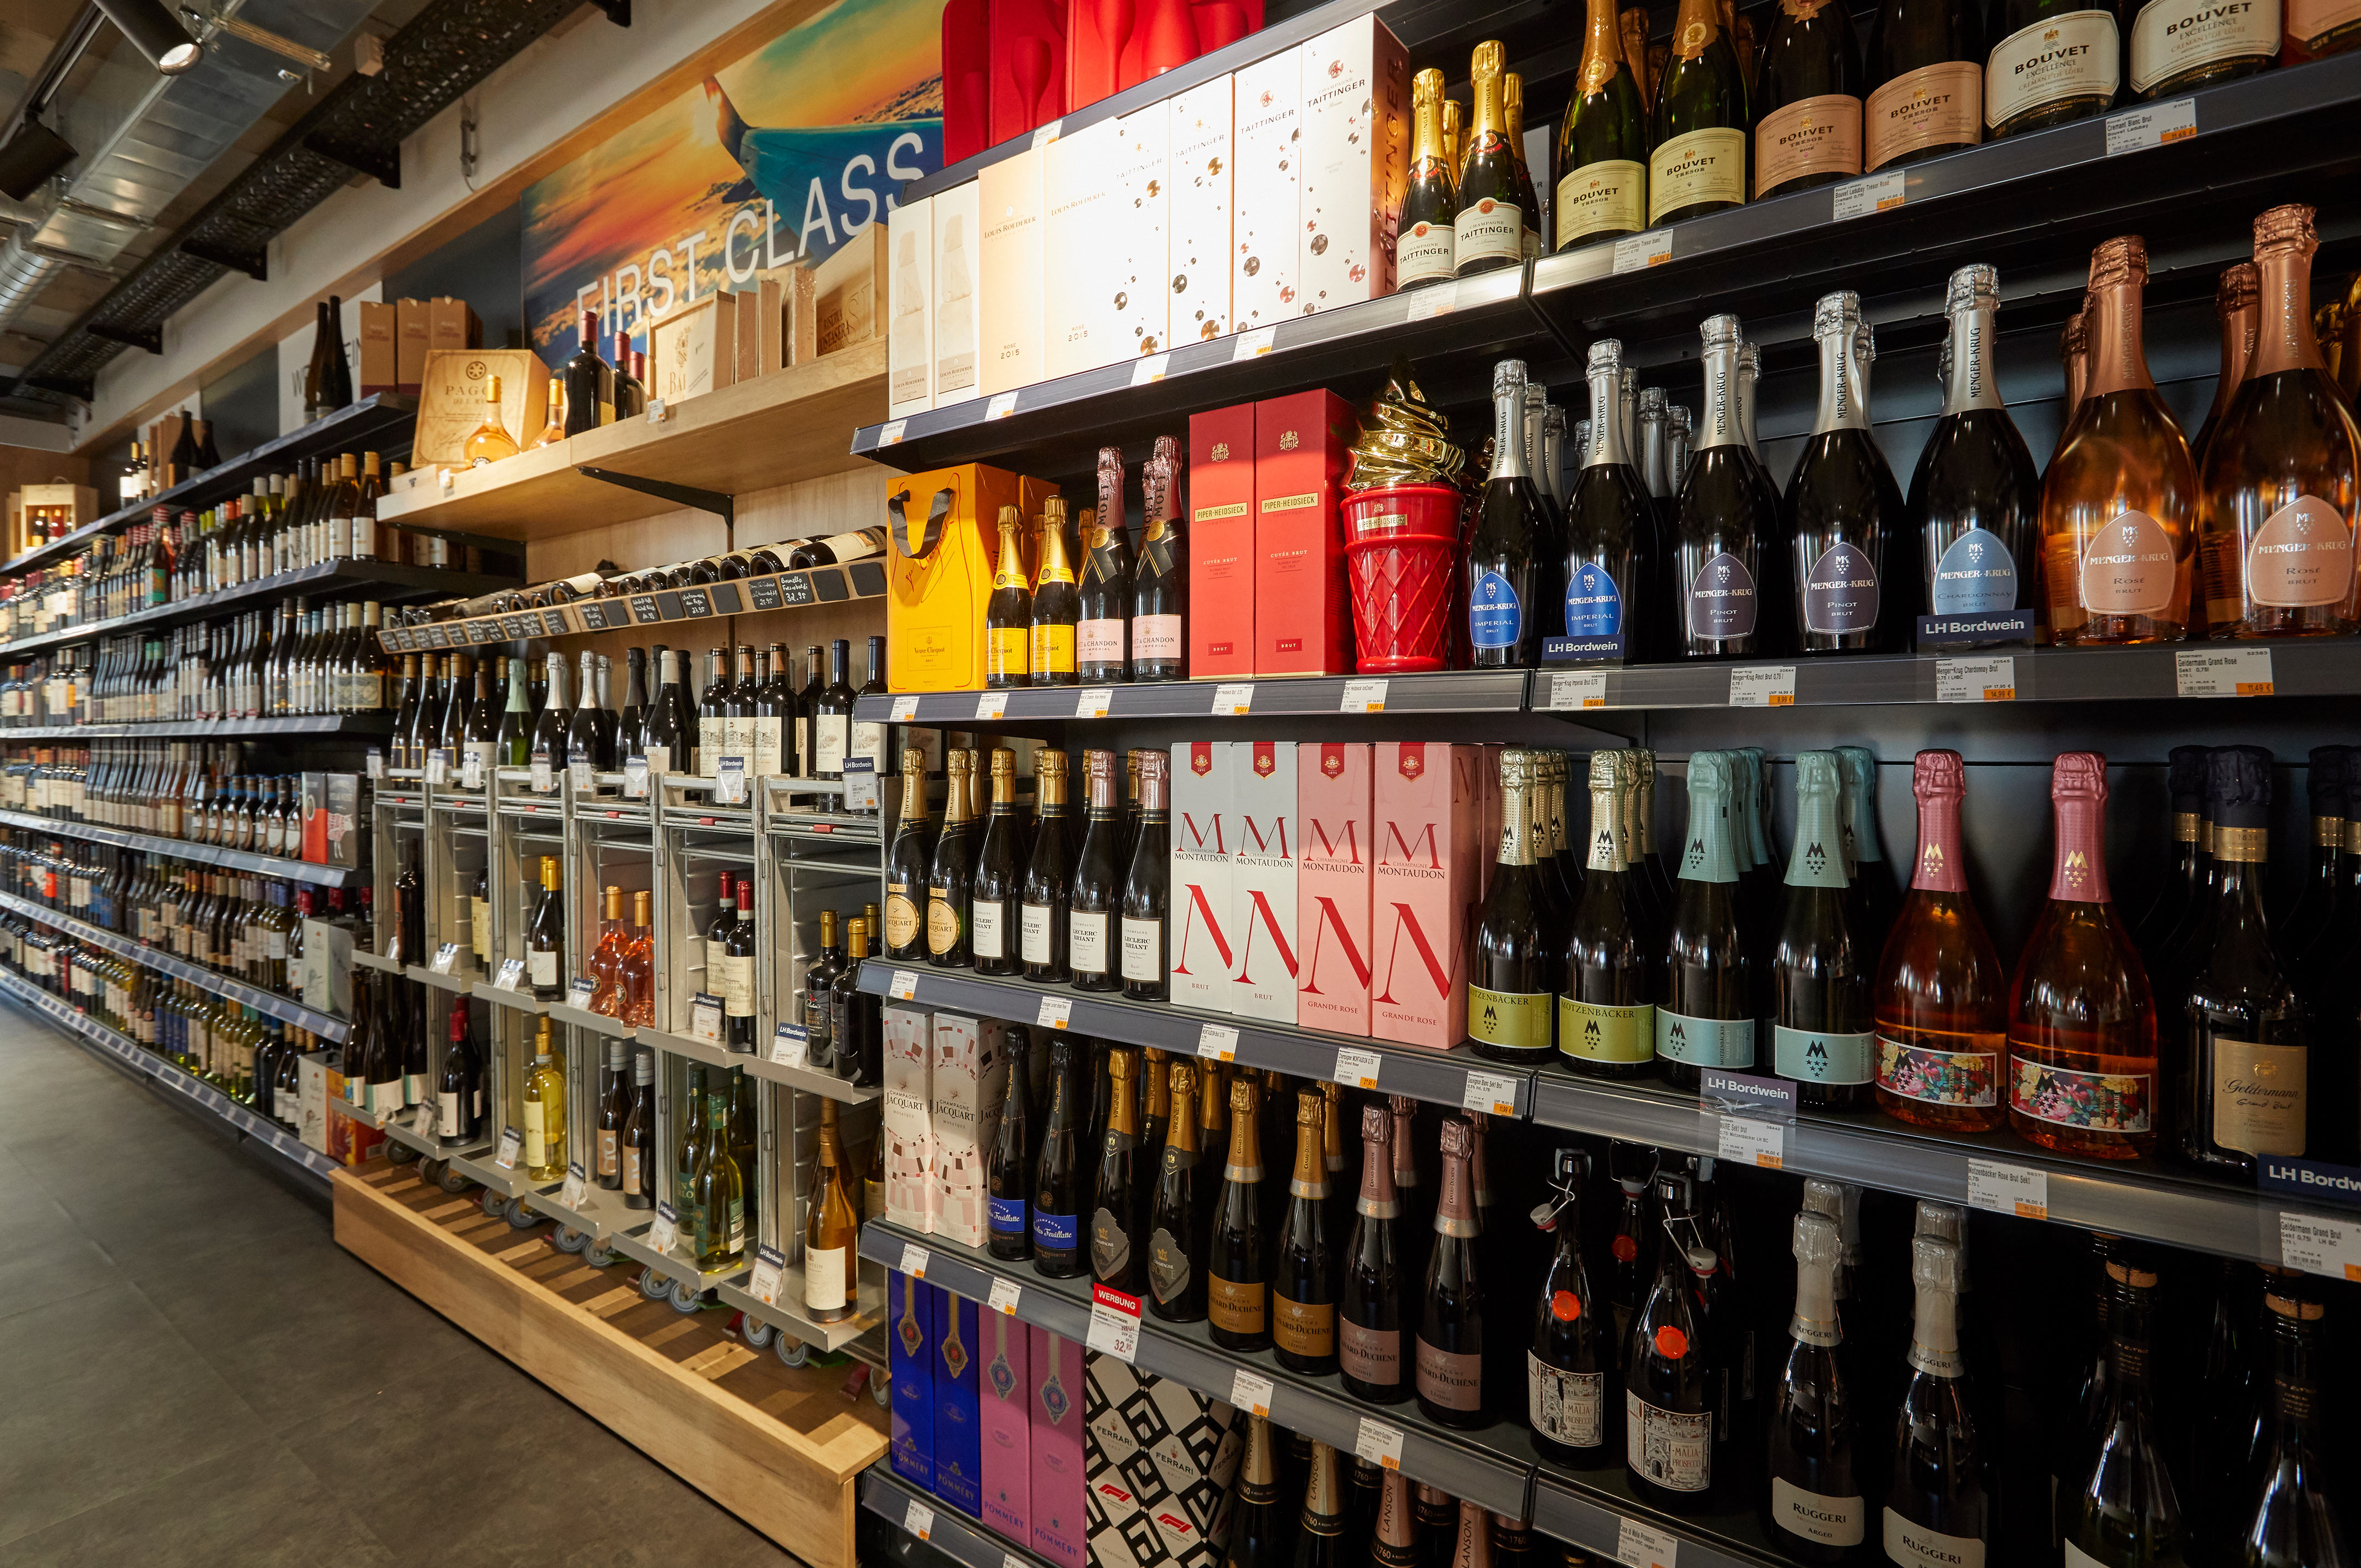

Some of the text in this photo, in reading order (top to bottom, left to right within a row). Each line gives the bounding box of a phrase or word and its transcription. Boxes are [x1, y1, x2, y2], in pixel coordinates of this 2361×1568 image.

[2167, 2, 2252, 36] BOUVET
[2179, 17, 2237, 40] EXCELLENCE
[2222, 25, 2246, 36] LOIRE
[2015, 45, 2090, 75] BOUVET
[2025, 58, 2076, 79] EXCELLENCE
[2064, 66, 2084, 77] LOIRE
[1307, 79, 1366, 107] TAITTINGER
[1890, 94, 1951, 118] BOUVET
[1902, 107, 1938, 121] TRESOR
[2142, 115, 2152, 123] Brut
[1241, 110, 1294, 134] TAITTINGER
[1780, 126, 1834, 145] BOUVET
[1789, 136, 1823, 148] TRESOR
[1175, 134, 1225, 158] TAITTINGER
[1116, 157, 1163, 181] TAITTINGER
[1666, 157, 1715, 176] BOUVET
[1675, 167, 1705, 178] TRESOR
[1051, 191, 1106, 216] LOUIS ROEDERER
[1573, 187, 1619, 206] BOUVET
[984, 216, 1036, 238] LOUIS ROEDERER
[1470, 220, 1504, 230] CHAMPAGNE
[576, 132, 924, 347] FIRST CLASS
[1460, 226, 1514, 242] TAITTINGER
[1407, 242, 1438, 253] CHAMPAGNE
[1400, 248, 1449, 265] TAITTINGER
[1068, 330, 1088, 342] 2015
[1000, 349, 1019, 359] 2015
[951, 366, 972, 374] ROEDERER
[1971, 327, 1981, 398] MENGER-KRUG
[905, 378, 925, 386] ROEDERER
[1837, 352, 1846, 419] MENGER-KRUG
[1716, 372, 1726, 435] MENGER-KRUG
[1596, 395, 1606, 456] MENGER-KRUG
[1496, 411, 1507, 470] MENGER-KRUG
[1264, 496, 1315, 511] PIPER-HEIDSIECK
[1197, 505, 1245, 519] PIPER-HEIDSIECK
[1270, 550, 1291, 559] CUVÉE
[2259, 540, 2346, 554] MENGER-KRUG
[2090, 553, 2168, 565] MENGER-KRUG
[1940, 568, 2010, 580] MENGER-KRUG
[1811, 578, 1874, 591] MENGER-KRUG
[1569, 595, 1617, 605] MENGER-KRUG
[1695, 588, 1752, 598] MENGER-KRUG
[1938, 591, 2012, 601] CHARDONNAY
[1472, 602, 1516, 612] MENGER-KRUG
[1571, 613, 1614, 621] IMPERIAL
[1925, 619, 2025, 634] LH Bordwein
[927, 646, 945, 655] Clicquot
[991, 646, 1012, 655] Clicquot
[1548, 641, 1618, 652] LH Bordwein
[1936, 667, 1963, 675] Menger-Krug
[1964, 666, 1988, 674] Chardonnay
[1237, 815, 1292, 859] M
[1303, 818, 1364, 864] M
[1379, 821, 1445, 869] M
[1174, 853, 1228, 863] MONTAUDON
[1236, 857, 1293, 868] MONTAUDON
[1303, 862, 1364, 874] MONTAUDON
[1378, 866, 1445, 879] MONTAUDON
[1124, 936, 1150, 944] LECLERC
[703, 997, 719, 1005] Bordwein
[1308, 1001, 1338, 1011] GRANDE
[1562, 1001, 1635, 1018] MOTZENBÄCKER
[1383, 1011, 1437, 1026] GRANDE ROSE
[786, 1028, 806, 1037] Bordwein
[890, 1090, 918, 1101] CHAMPAGNE
[1709, 1077, 1789, 1099] LH Bordwein
[2222, 1078, 2302, 1099] Geldermann
[885, 1092, 924, 1110] JACQUART
[939, 1099, 970, 1111] CHAMPAGNE
[935, 1101, 975, 1121] JACQUART
[1998, 1171, 2009, 1180] Rosé
[2020, 1176, 2030, 1184] Sekt
[2269, 1164, 2361, 1191] LH Bordw
[994, 1211, 1020, 1223] Feuillatte
[1043, 1228, 1073, 1239] Feuillatte
[2281, 1221, 2342, 1240] Geldermann Grand Brut
[1098, 1290, 1135, 1310] WERBUNG
[1797, 1325, 1832, 1339] RUGGERI
[1913, 1352, 1951, 1369] RUGGERI
[1565, 1416, 1593, 1425] PROSECCO
[1096, 1426, 1133, 1447] FERRARI
[894, 1450, 929, 1476] POMMERY
[1156, 1452, 1194, 1476] FERRARI
[1672, 1458, 1701, 1468] PROSECCO
[1310, 1453, 1319, 1500] LANSON
[938, 1472, 974, 1501] POMMERY
[984, 1500, 1024, 1529] POMMERY
[1383, 1483, 1392, 1533] LANSON
[1793, 1502, 1846, 1524] RUGGERI
[1808, 1527, 1833, 1538] ARGEO
[1035, 1527, 1078, 1558] POMMERY
[1903, 1534, 1962, 1565] RUGGERI
